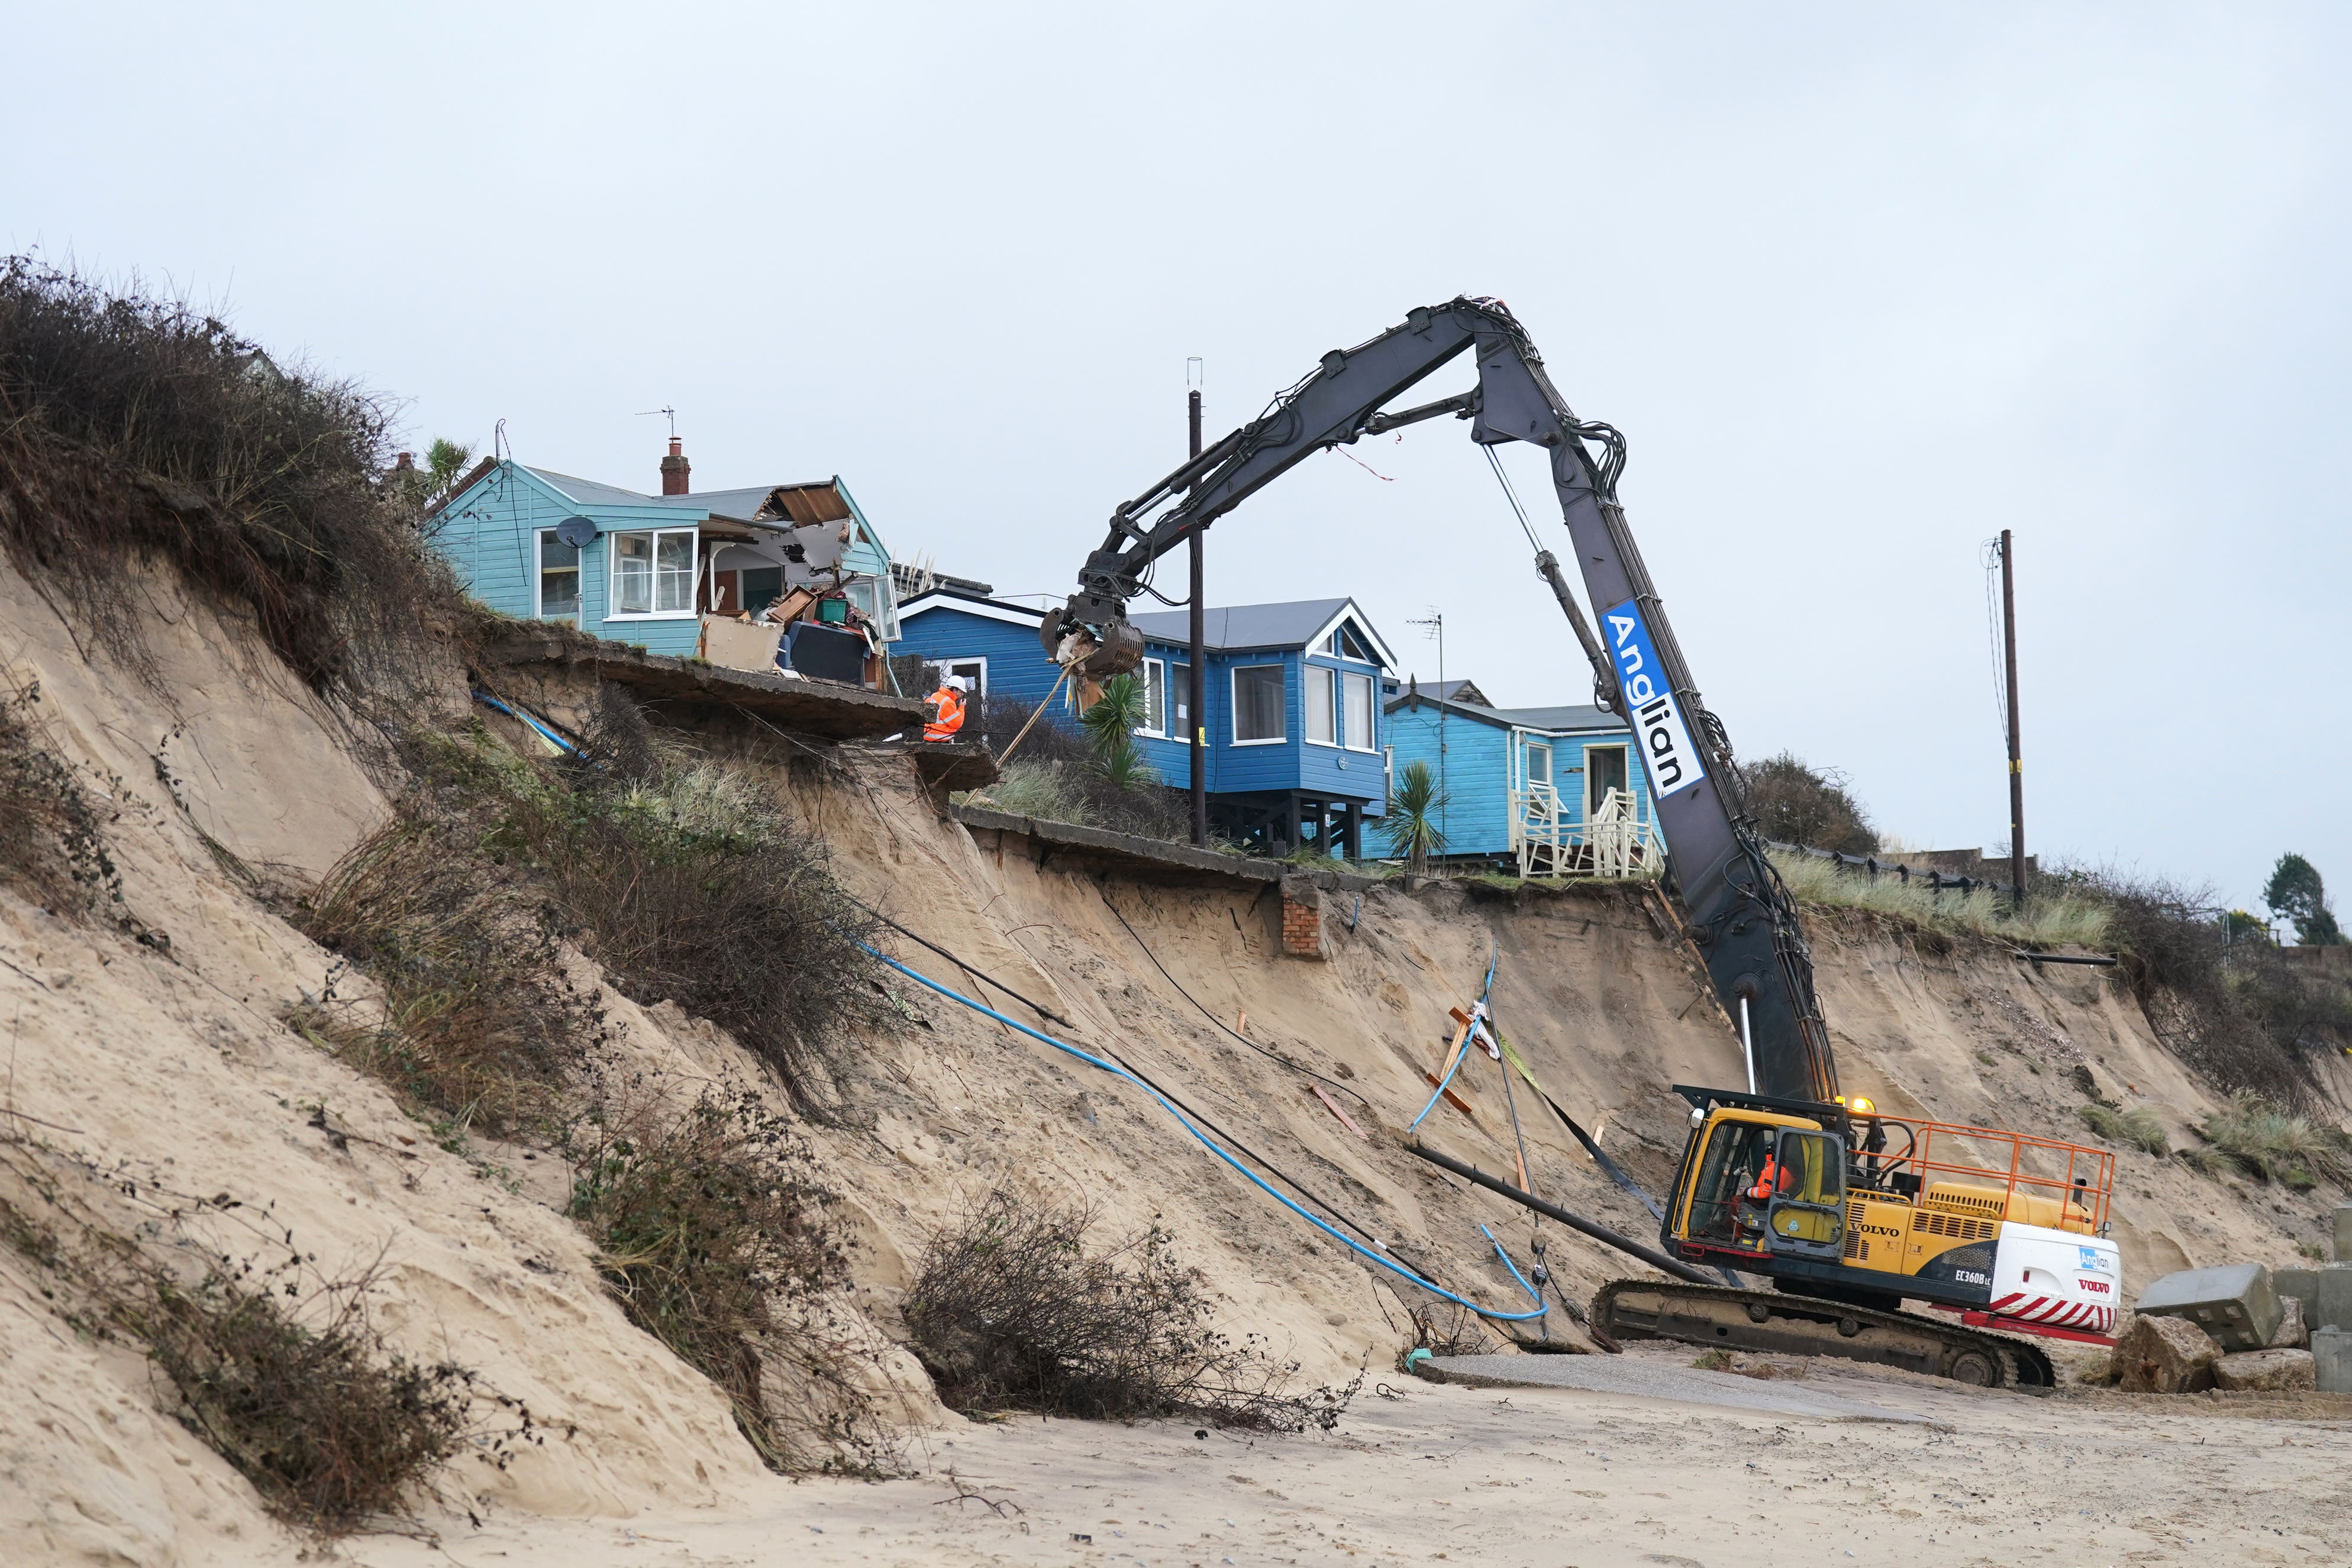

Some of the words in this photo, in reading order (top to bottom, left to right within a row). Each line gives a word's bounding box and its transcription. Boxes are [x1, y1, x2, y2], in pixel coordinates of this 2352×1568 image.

[1608, 615, 1682, 788] Anglian
[1849, 1222, 1899, 1237] VOLVO
[2081, 1251, 2109, 1270] Anglian
[1955, 1269, 1985, 1285] EC360B
[1985, 1277, 1992, 1286] LC
[2078, 1279, 2109, 1294] VOLVO
